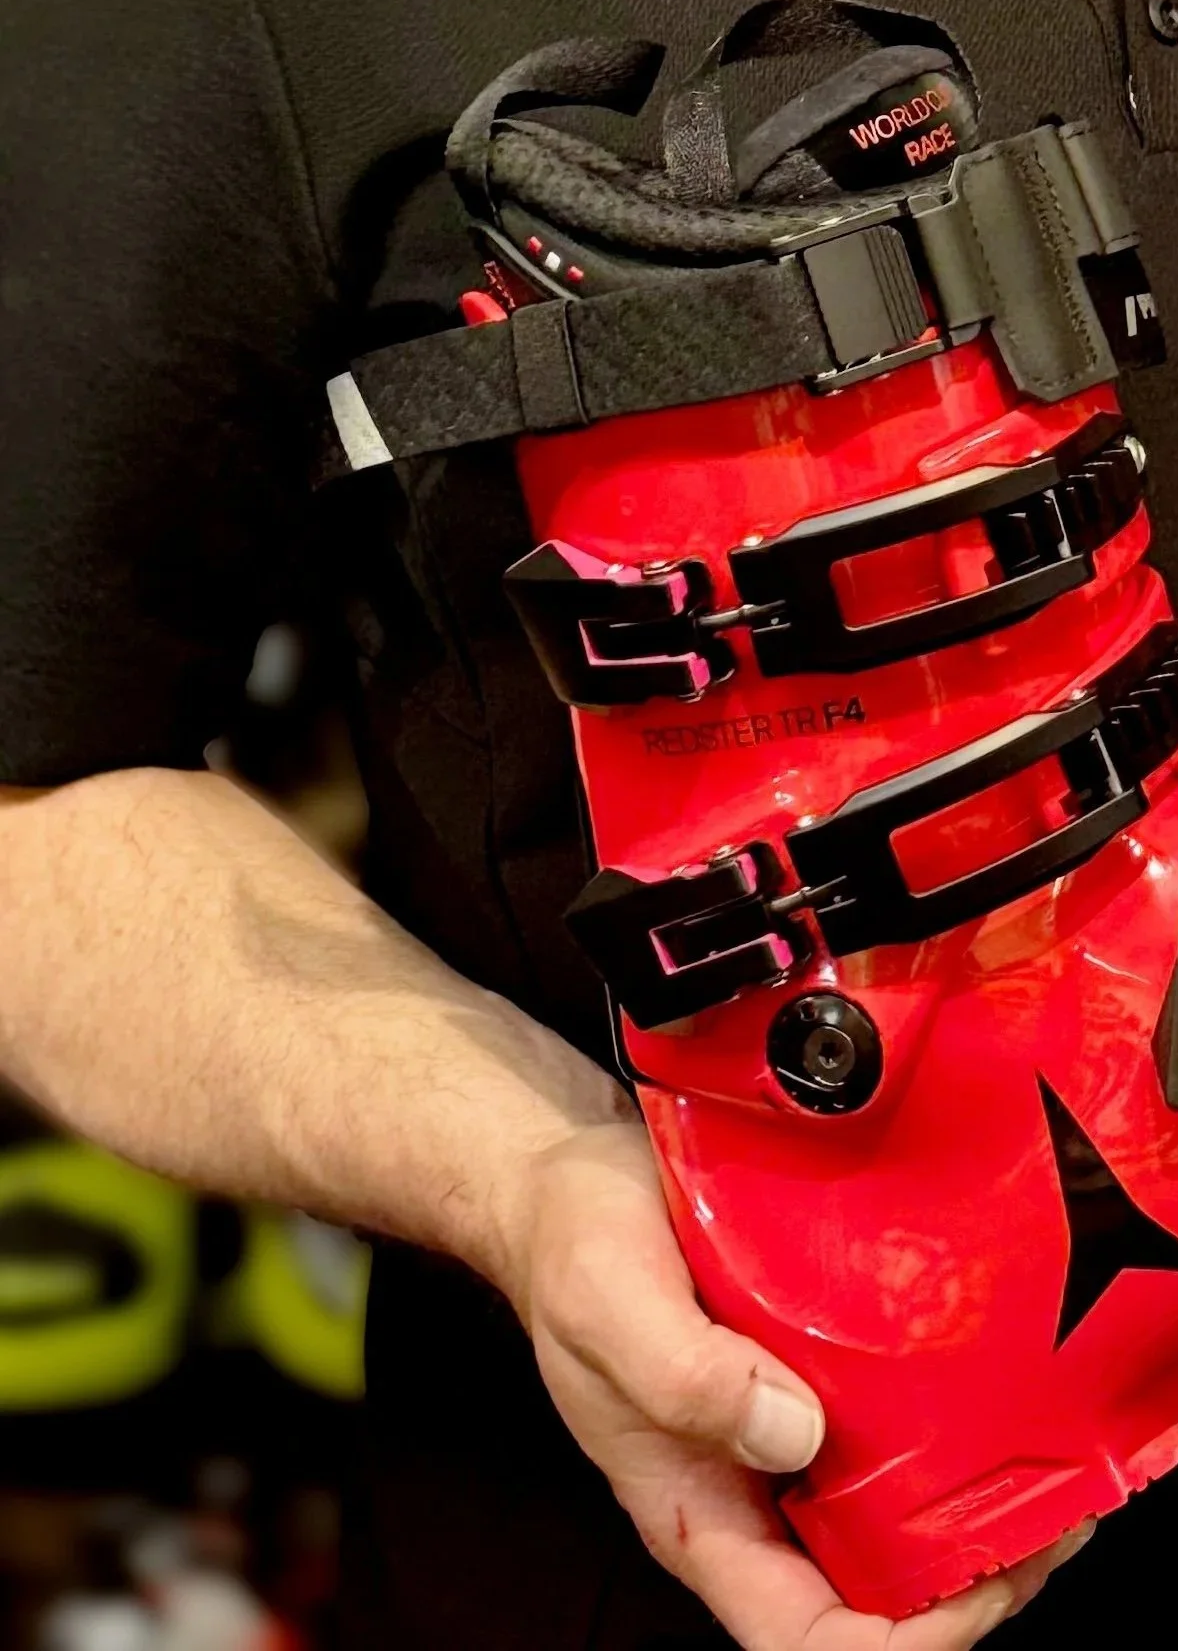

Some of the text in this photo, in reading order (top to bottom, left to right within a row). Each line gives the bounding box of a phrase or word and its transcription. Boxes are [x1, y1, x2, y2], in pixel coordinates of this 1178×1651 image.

[904, 122, 956, 166] RACE
[642, 695, 866, 756] REDSTER TR F4
